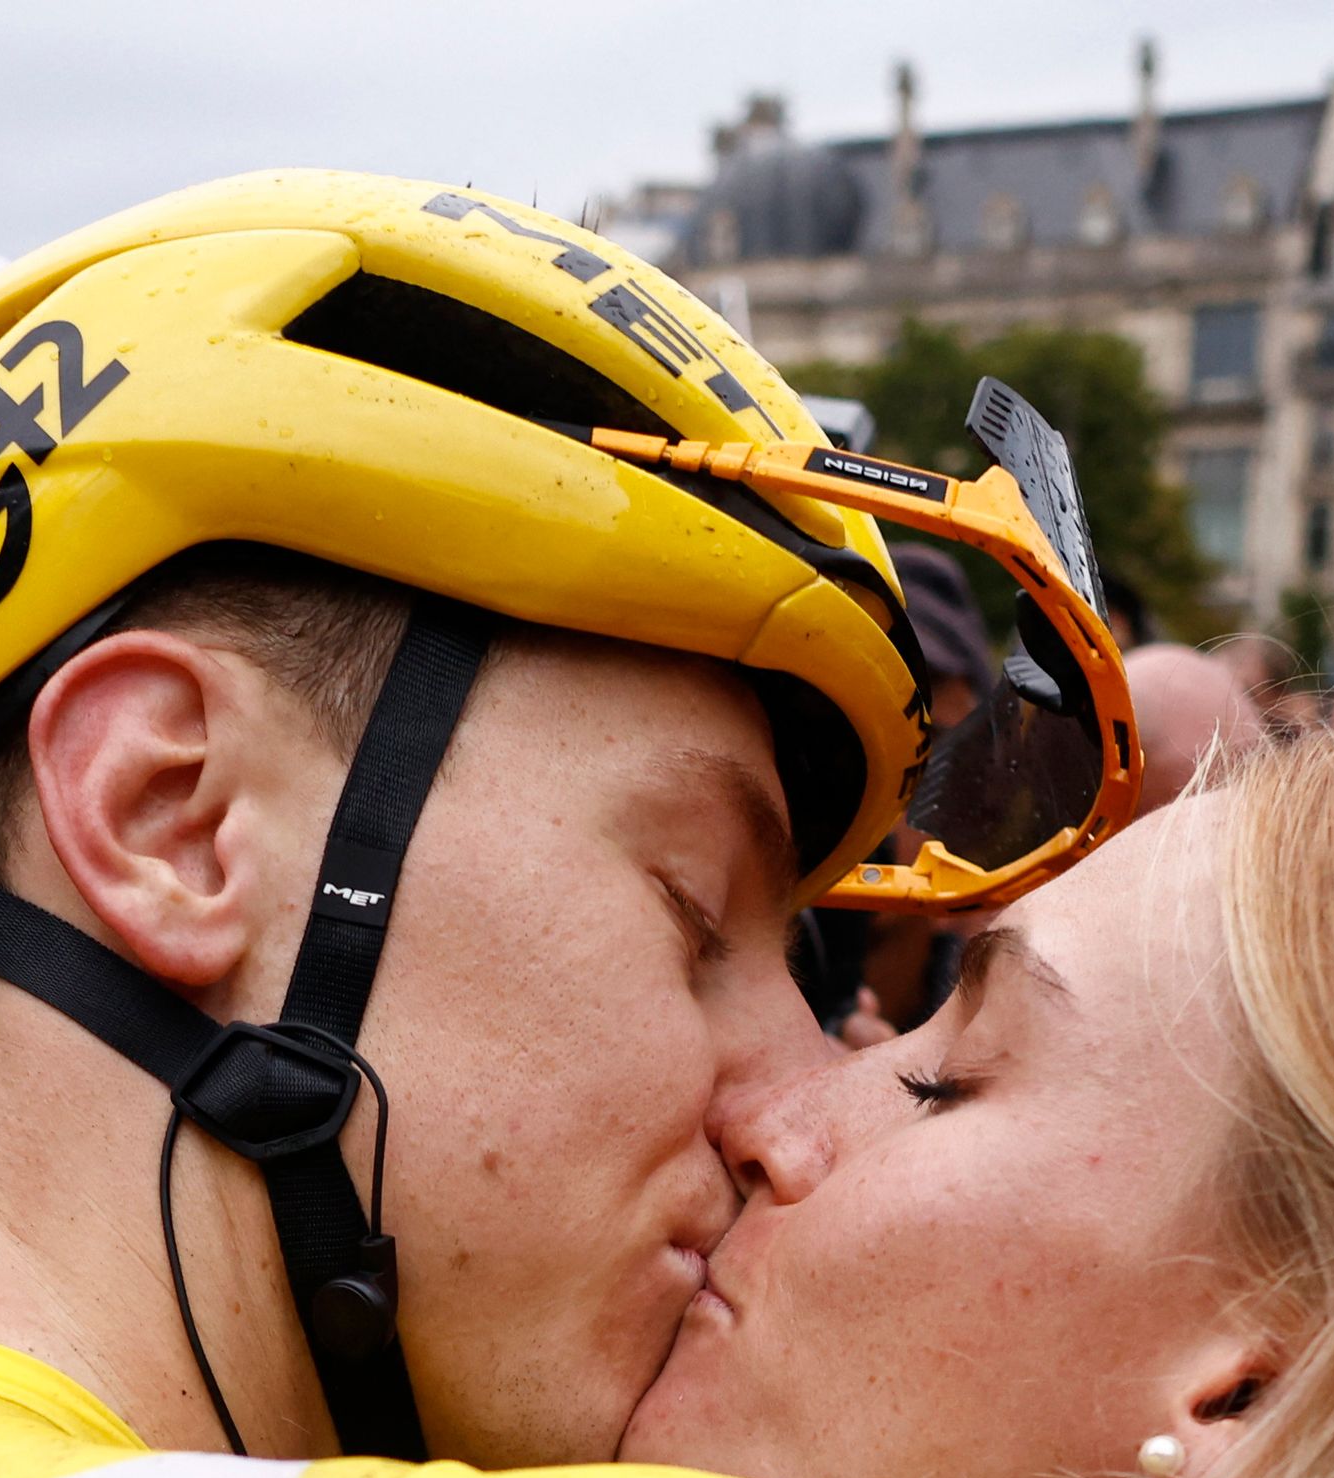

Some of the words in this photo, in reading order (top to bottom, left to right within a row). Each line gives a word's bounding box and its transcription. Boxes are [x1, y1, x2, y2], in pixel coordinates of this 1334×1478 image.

[419, 191, 788, 441] MET
[824, 457, 929, 491] SCICON
[322, 882, 386, 907] MET
